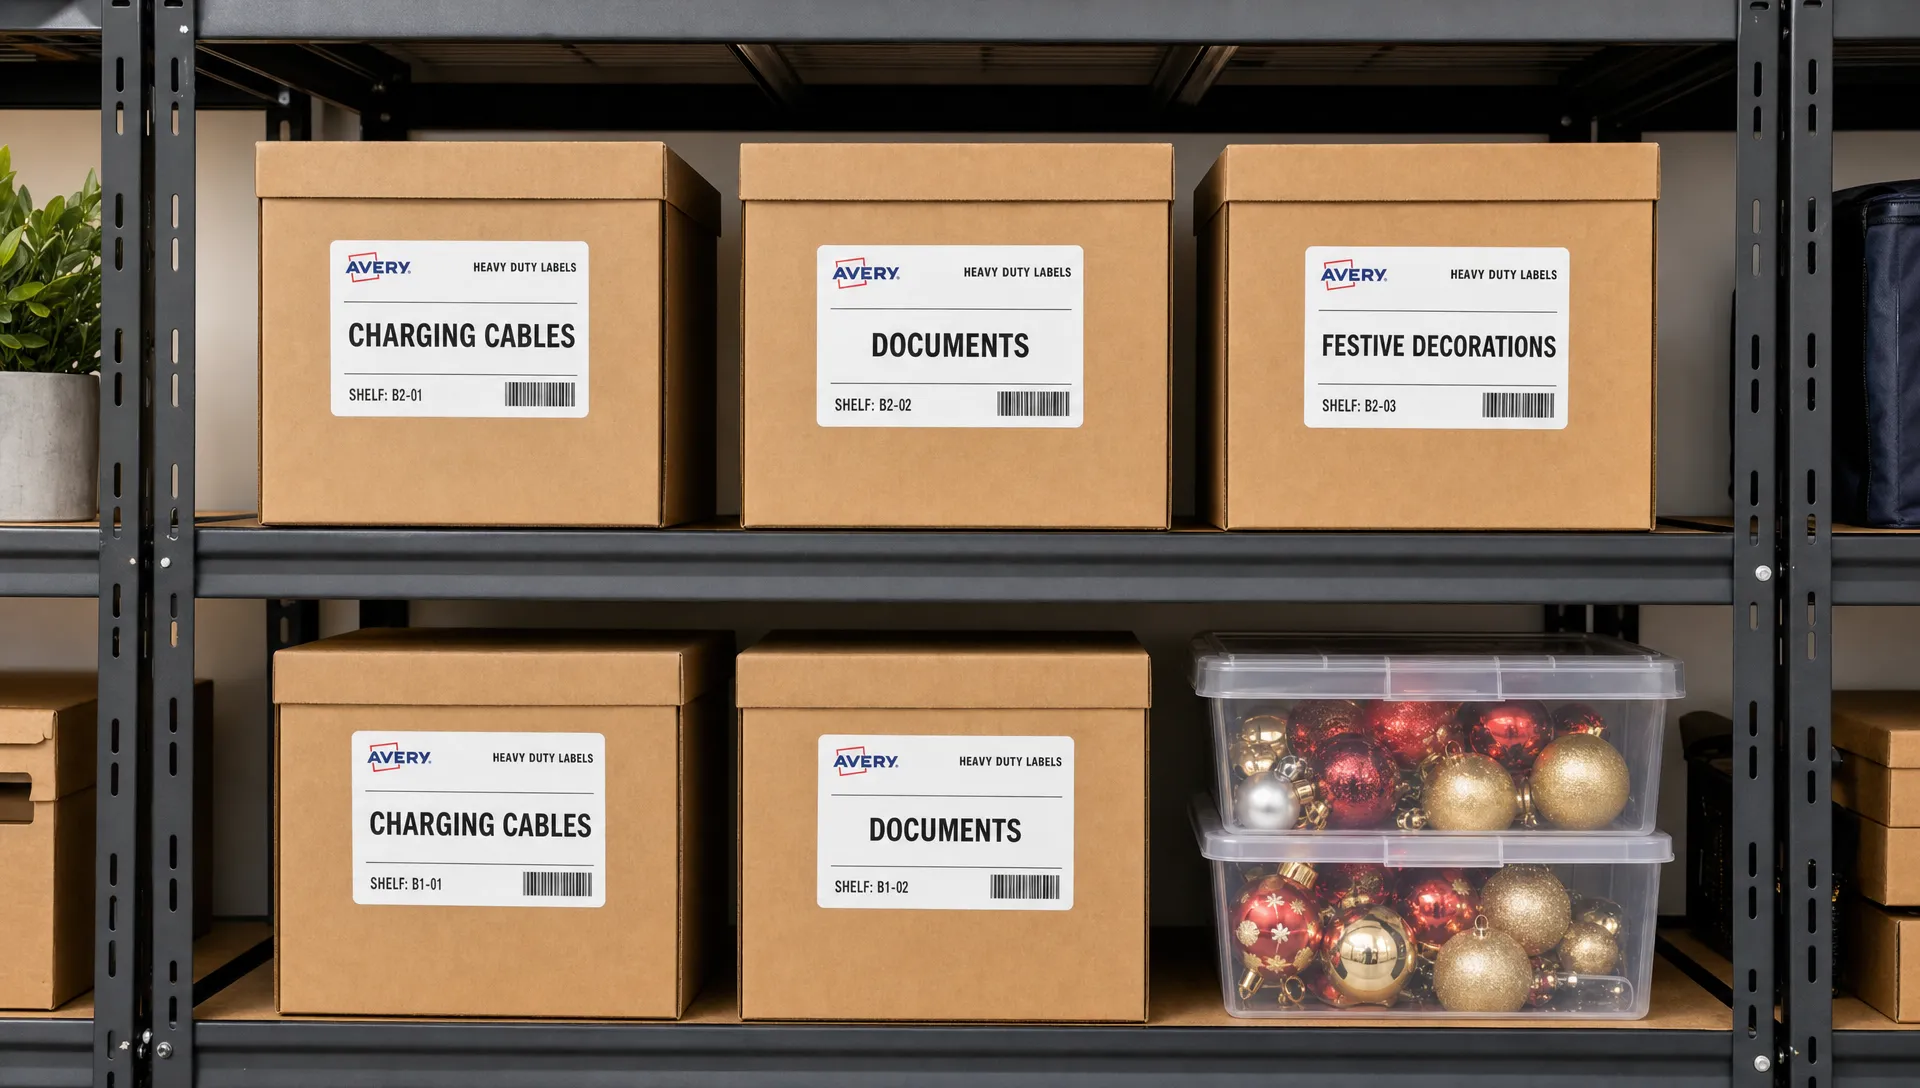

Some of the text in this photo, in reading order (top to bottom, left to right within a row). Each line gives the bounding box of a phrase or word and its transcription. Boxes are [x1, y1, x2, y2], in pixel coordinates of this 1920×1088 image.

[473, 261, 577, 273] HEAVY DUTY LABELS
[963, 266, 1072, 278] HEAVY DUTY LABELS
[1450, 268, 1558, 280] HEAVY DUTY LABELS
[348, 322, 576, 349] CHARGING CABLES
[872, 331, 1030, 359] DOCUMENTS
[1322, 333, 1557, 359] FESTIVE DECORATIONS
[348, 387, 422, 402] SHELF: B2-01
[834, 397, 912, 412] SHELF: B2-02
[1322, 398, 1397, 413] SHELF: B2-03
[492, 752, 594, 764] HEAVY DUTY LABELS
[959, 756, 1063, 767] HEAVY DUTY LABELS
[369, 810, 592, 838] CHARGING CABLES
[869, 817, 1022, 843] DOCUMENTS
[370, 876, 442, 891] SHELF: B1-01
[834, 879, 909, 894] SHELF: B1-02
